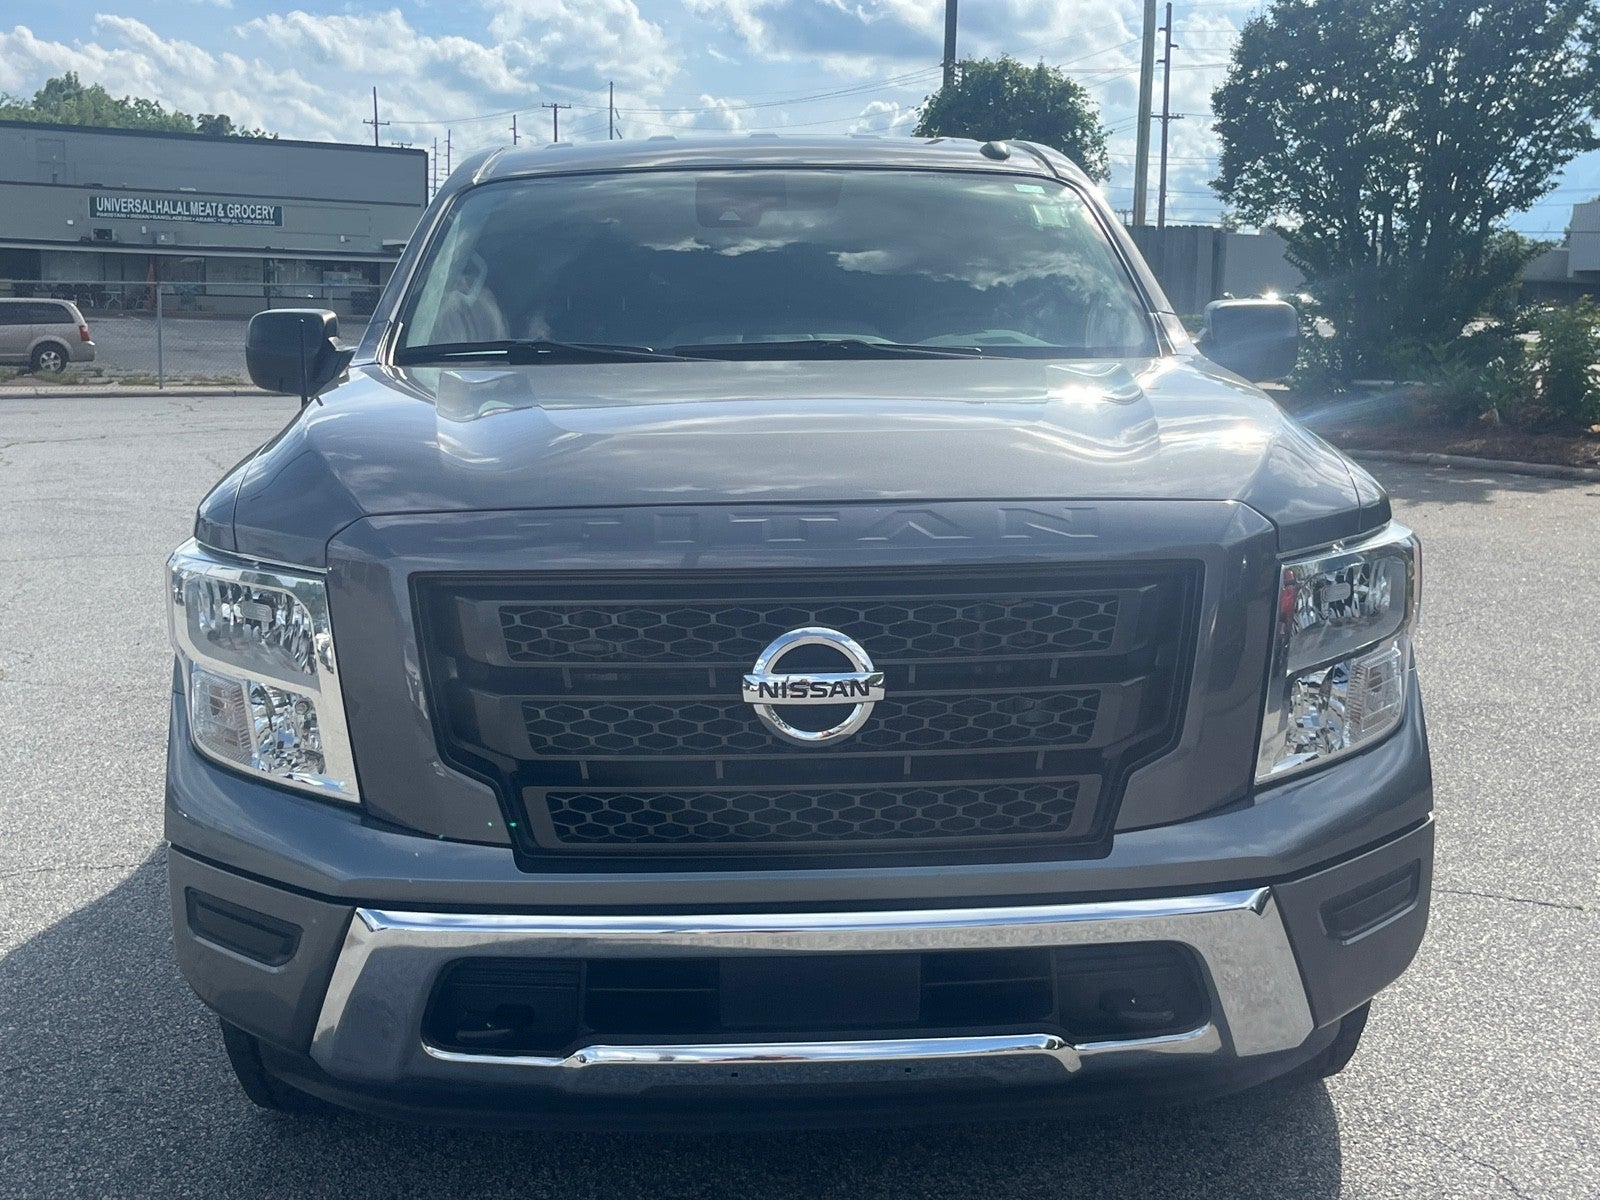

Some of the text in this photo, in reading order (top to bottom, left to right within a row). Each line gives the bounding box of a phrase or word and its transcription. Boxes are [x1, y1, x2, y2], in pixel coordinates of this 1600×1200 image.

[96, 197, 155, 213] UNIVERSAL
[155, 199, 189, 215] HALAL
[227, 204, 275, 219] GROCERY
[515, 506, 1099, 545] TITAN
[758, 680, 870, 699] NISSAN
